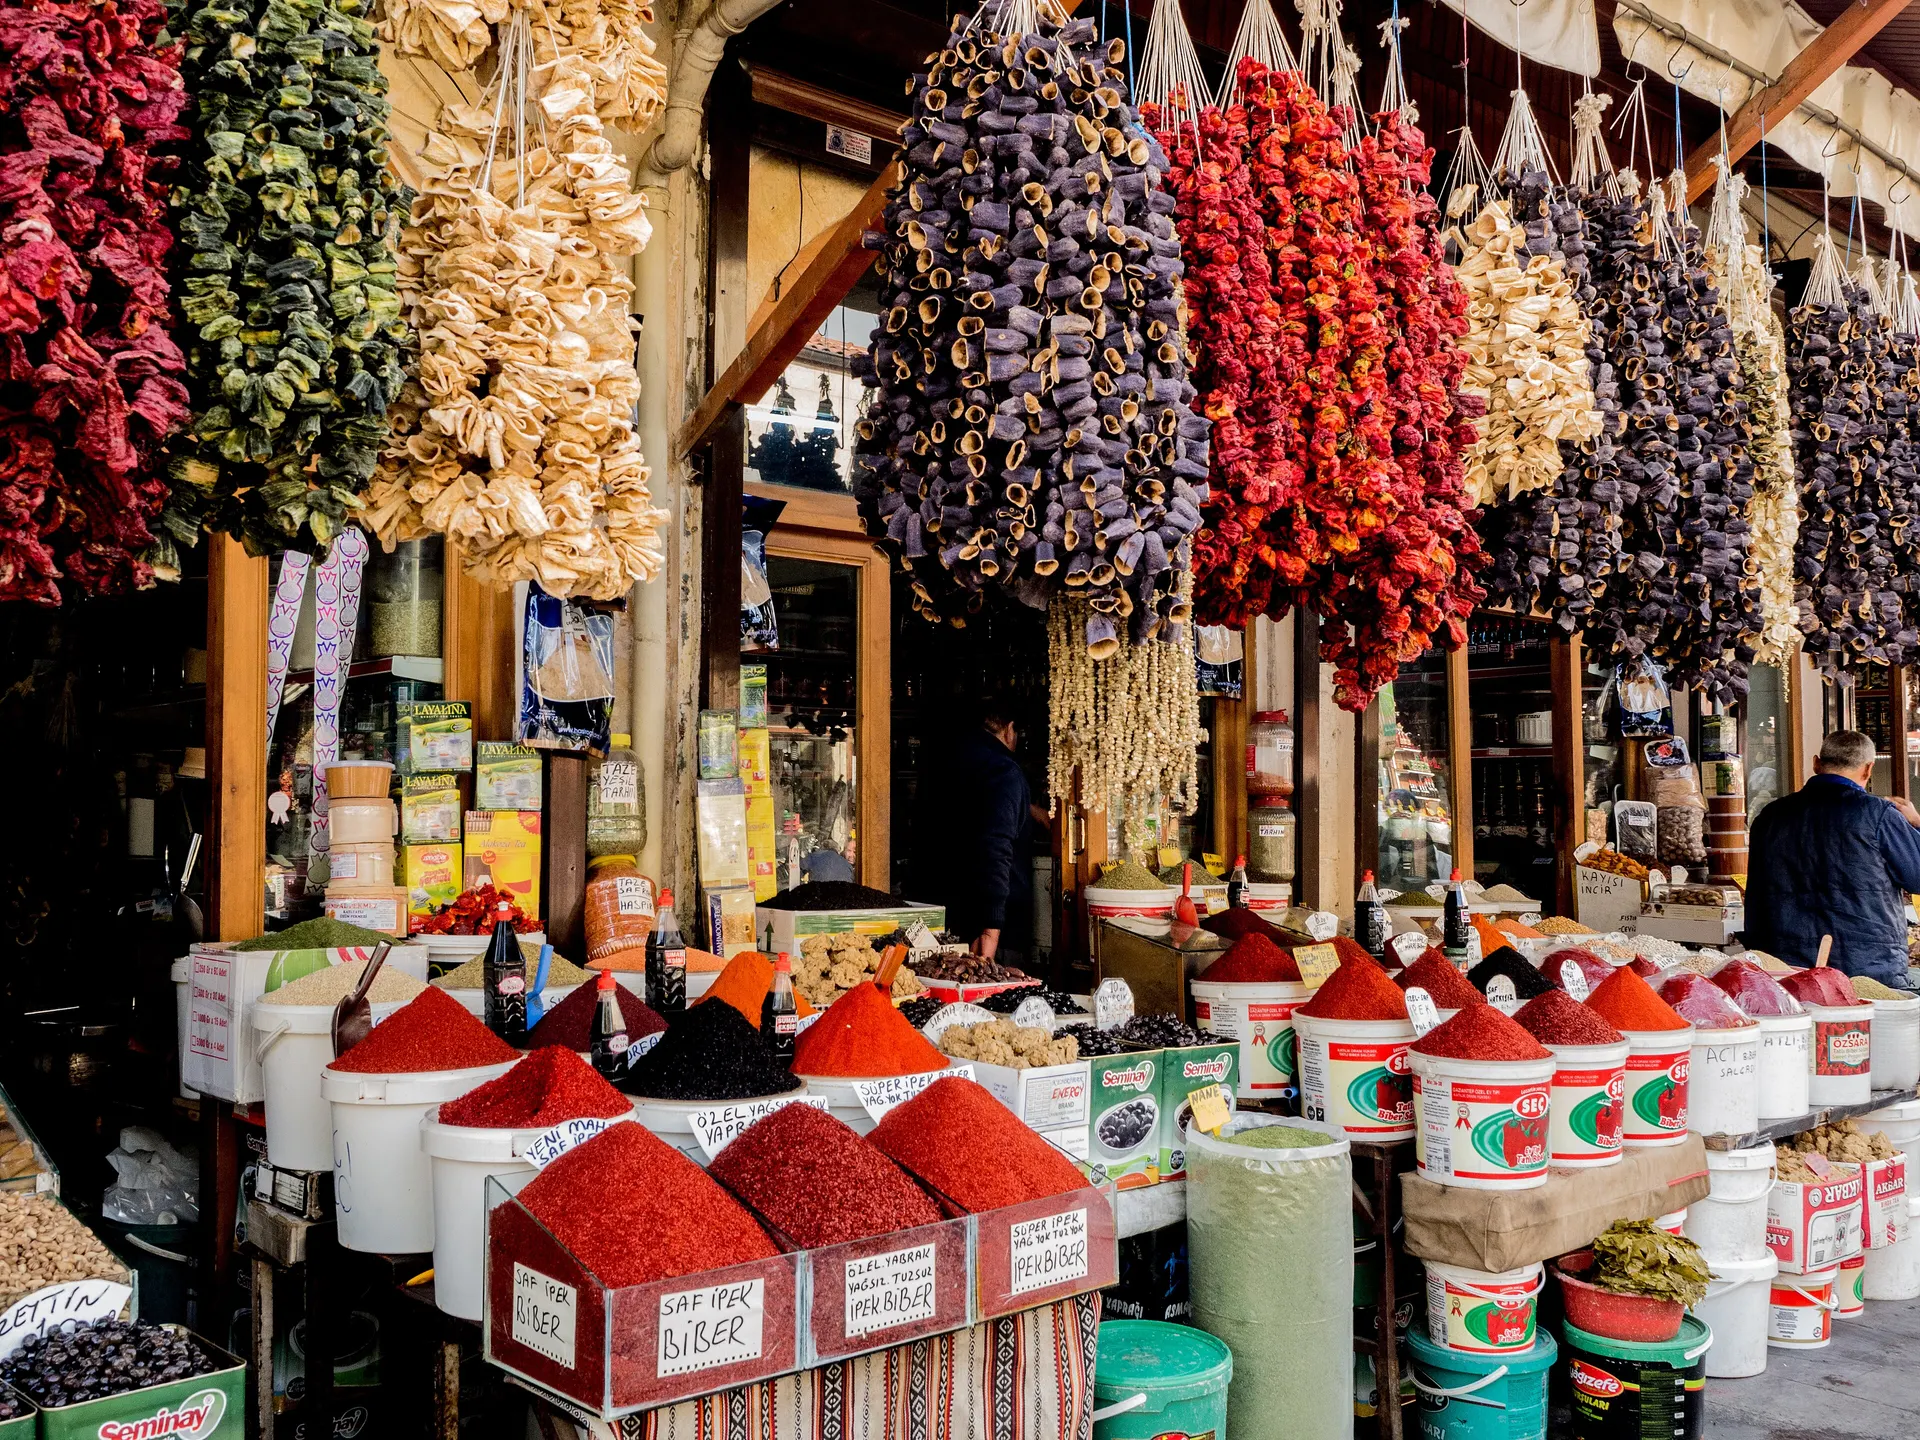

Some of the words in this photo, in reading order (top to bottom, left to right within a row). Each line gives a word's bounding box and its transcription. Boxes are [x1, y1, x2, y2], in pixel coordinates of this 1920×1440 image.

[415, 703, 467, 715] LAYALINA
[481, 745, 537, 755] LAYALINA
[603, 763, 635, 775] TAZE
[406, 774, 457, 787] LAYALINA
[1582, 871, 1624, 887] KAYISI
[1184, 1060, 1225, 1077] Seminay
[860, 1079, 902, 1095] SÜPER
[1103, 1070, 1147, 1087] Seminay
[1191, 1086, 1220, 1105] NANE
[1521, 1097, 1545, 1115] SEÇ
[526, 1125, 561, 1160] YENİ
[540, 1140, 567, 1165] SAF
[1875, 1177, 1904, 1195] AKBAR
[1013, 1219, 1047, 1238] SÜPER
[1052, 1213, 1079, 1228] İPEK
[1036, 1232, 1051, 1243] YOK
[1053, 1228, 1069, 1239] TUZ
[1069, 1223, 1084, 1235] YOK
[892, 1266, 932, 1284] TUZSUZ
[515, 1268, 538, 1289] SAF
[545, 1280, 570, 1306] İPEK
[661, 1294, 703, 1315] SAF
[711, 1282, 753, 1311] İPEK
[517, 1295, 565, 1343] BİBER
[664, 1316, 746, 1360] BİBER
[99, 1404, 208, 1440] Seminay
